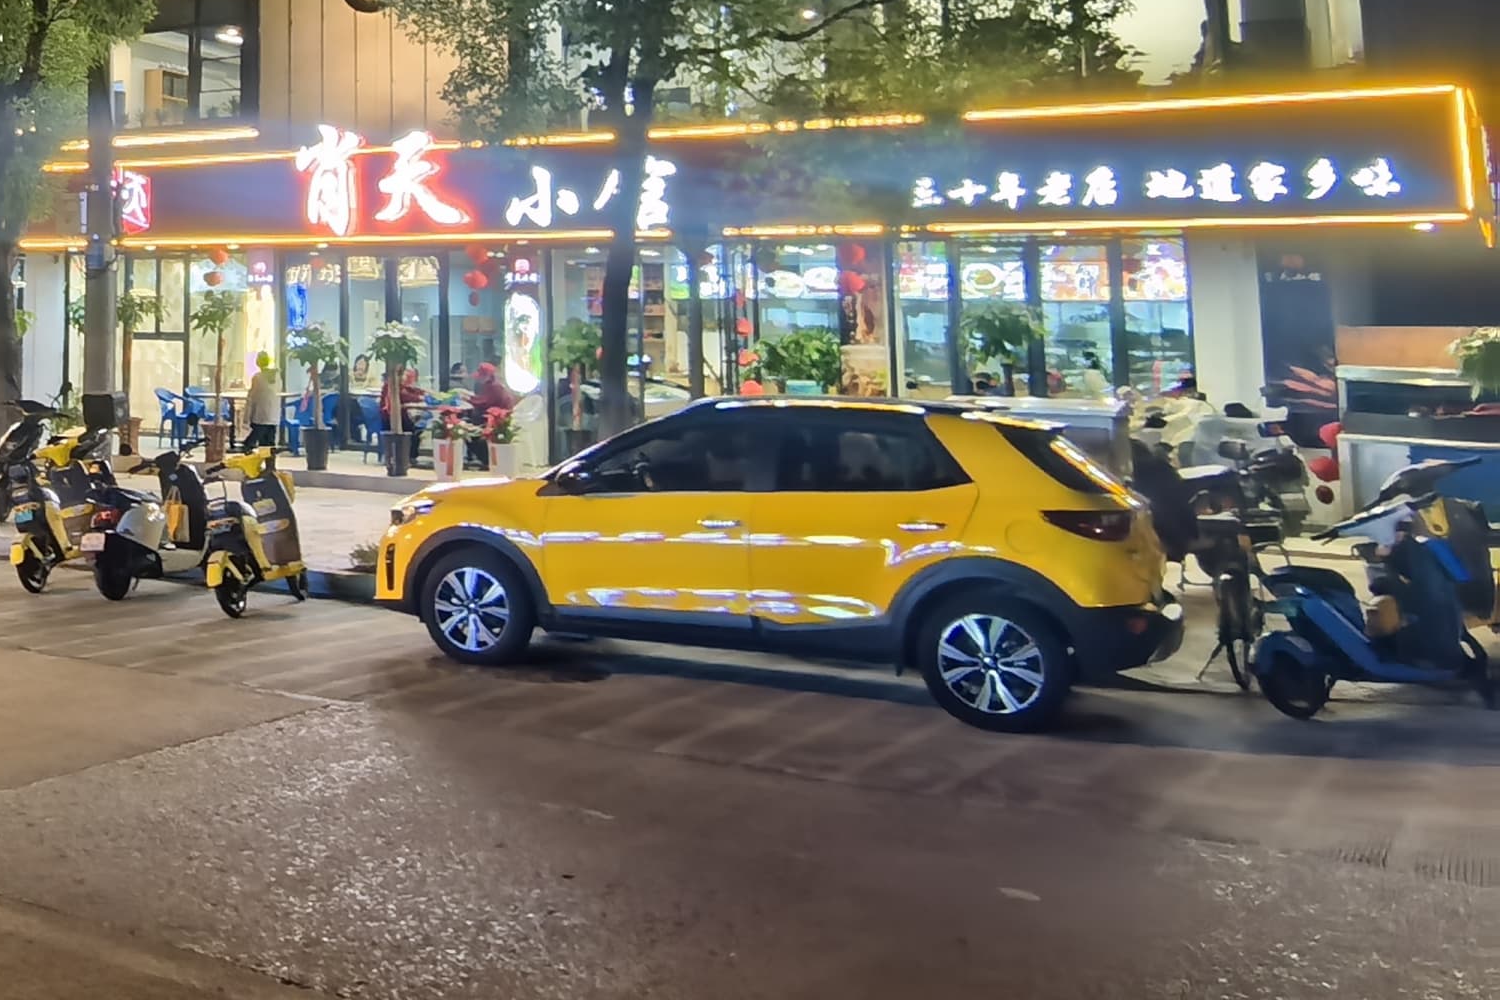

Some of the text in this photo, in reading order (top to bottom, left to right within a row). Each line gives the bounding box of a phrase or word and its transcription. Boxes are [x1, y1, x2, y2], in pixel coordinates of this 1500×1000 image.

[911, 156, 1402, 210] 三十年老店 地道家乡味
